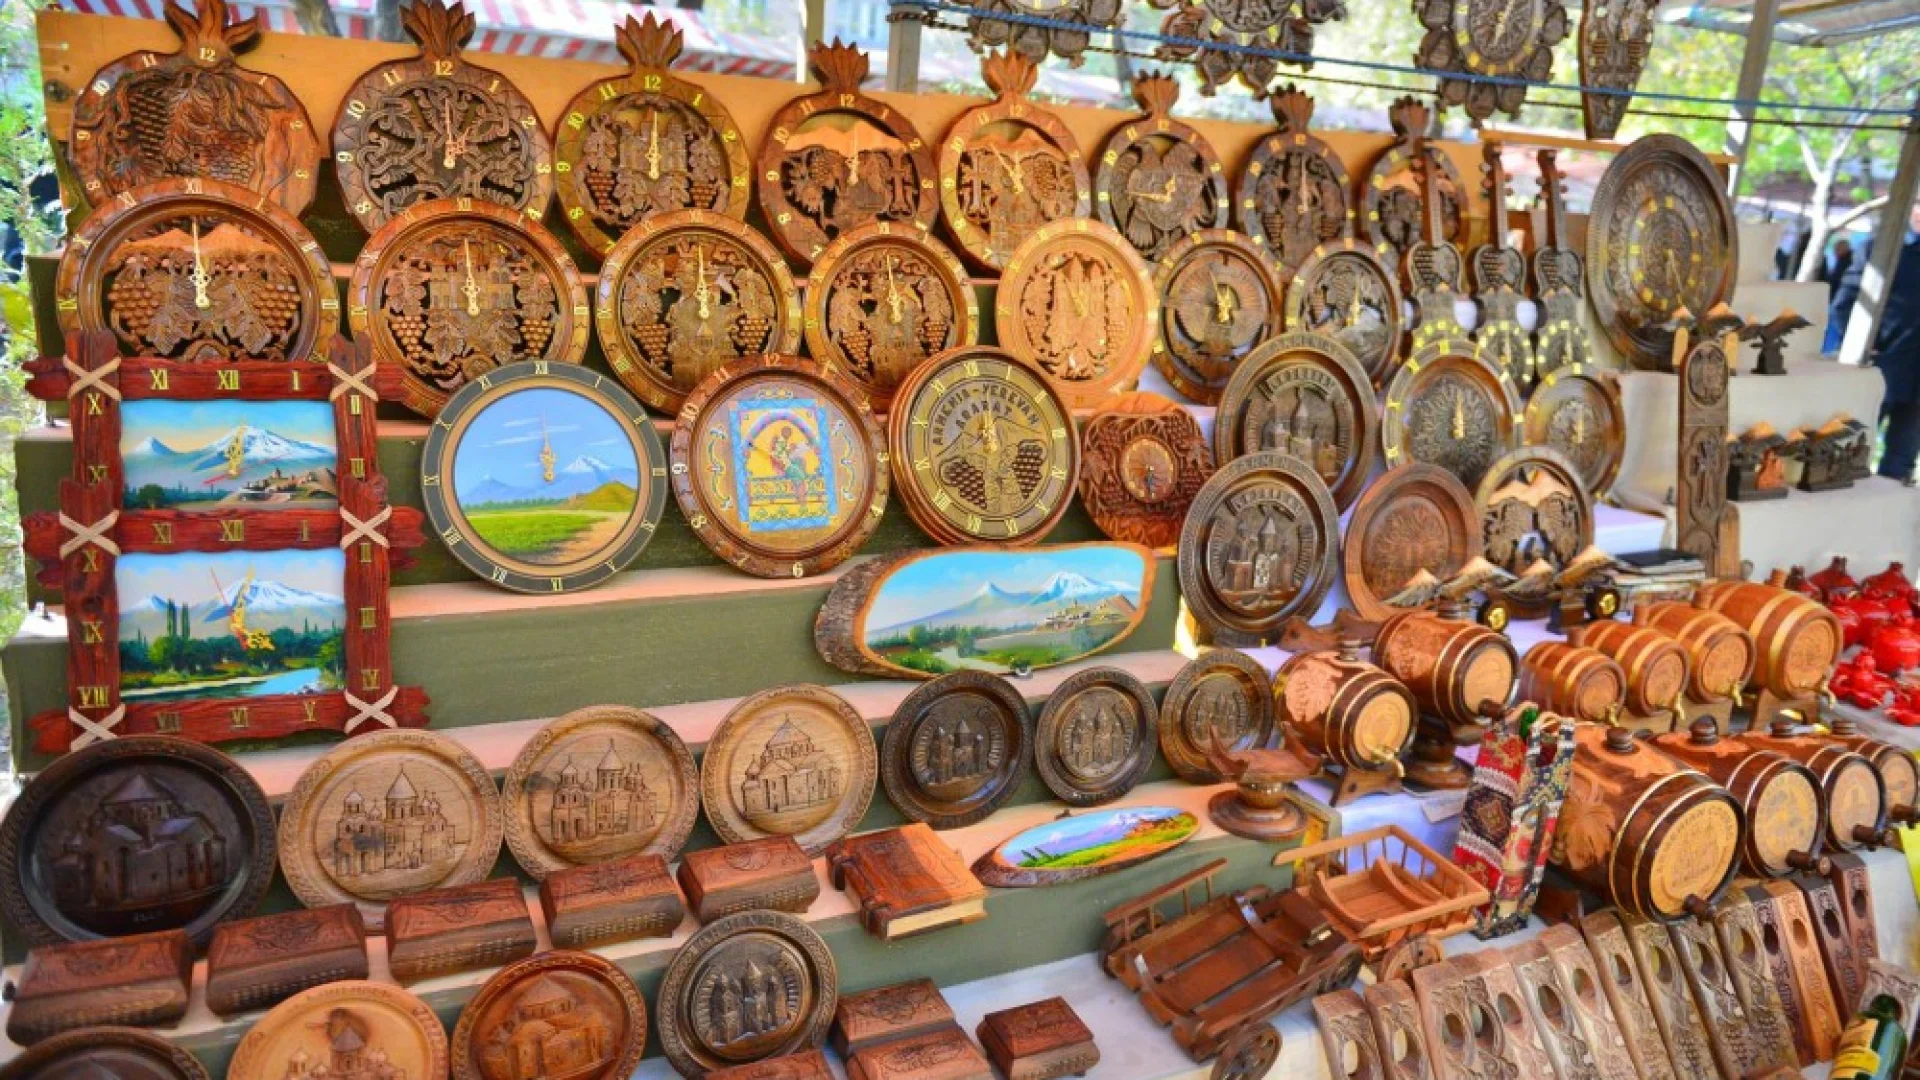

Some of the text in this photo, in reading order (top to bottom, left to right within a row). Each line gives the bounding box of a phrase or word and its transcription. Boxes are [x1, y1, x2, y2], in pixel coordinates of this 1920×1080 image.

[141, 54, 157, 67] 11
[200, 47, 216, 62] 12
[434, 61, 453, 76] 12
[382, 69, 402, 85] 11
[644, 75, 661, 90] 12
[92, 80, 111, 96] 10
[490, 80, 499, 92] 1
[599, 84, 616, 100] 11
[693, 93, 703, 106] 1
[800, 100, 814, 114] 11
[840, 93, 854, 107] 12
[346, 99, 365, 120] 10
[1010, 104, 1022, 117] 12
[521, 116, 536, 129] 2
[567, 112, 584, 130] 10
[76, 130, 91, 140] 9
[773, 127, 789, 144] 10
[337, 151, 354, 162] 9
[536, 163, 551, 174] 3
[556, 162, 570, 172] 9
[184, 178, 202, 194] XII
[117, 191, 137, 207] XI
[457, 198, 473, 211] XII
[355, 200, 372, 214] 8
[535, 361, 548, 374] XII
[764, 354, 780, 367] 12
[714, 368, 731, 382] 11
[964, 361, 980, 376] XII
[1006, 365, 1012, 380] I
[150, 369, 168, 390] XI
[217, 369, 240, 390] XII
[293, 369, 299, 391] I
[479, 375, 492, 389] XI
[595, 376, 602, 388] I
[931, 379, 946, 395] XI
[88, 393, 102, 415] X
[350, 394, 360, 415] II
[681, 402, 700, 421] 10
[933, 388, 970, 445] ARMENIA
[982, 383, 1039, 424] YEREVAN
[956, 400, 1012, 430] ARARAT
[436, 418, 452, 430] X
[912, 416, 928, 428] X
[672, 462, 688, 474] 9
[933, 488, 951, 510] VIII
[1035, 500, 1049, 515] V
[690, 514, 707, 529] 8
[154, 522, 172, 544] XI
[222, 520, 244, 542] XII
[301, 520, 308, 541] I
[361, 543, 371, 562] II
[82, 550, 97, 572] X
[792, 562, 803, 577] 6
[361, 607, 376, 628] III
[83, 621, 103, 644] IX
[78, 686, 109, 708] VIII
[230, 707, 249, 727] VI
[304, 701, 316, 722] V
[156, 712, 180, 732] VII
